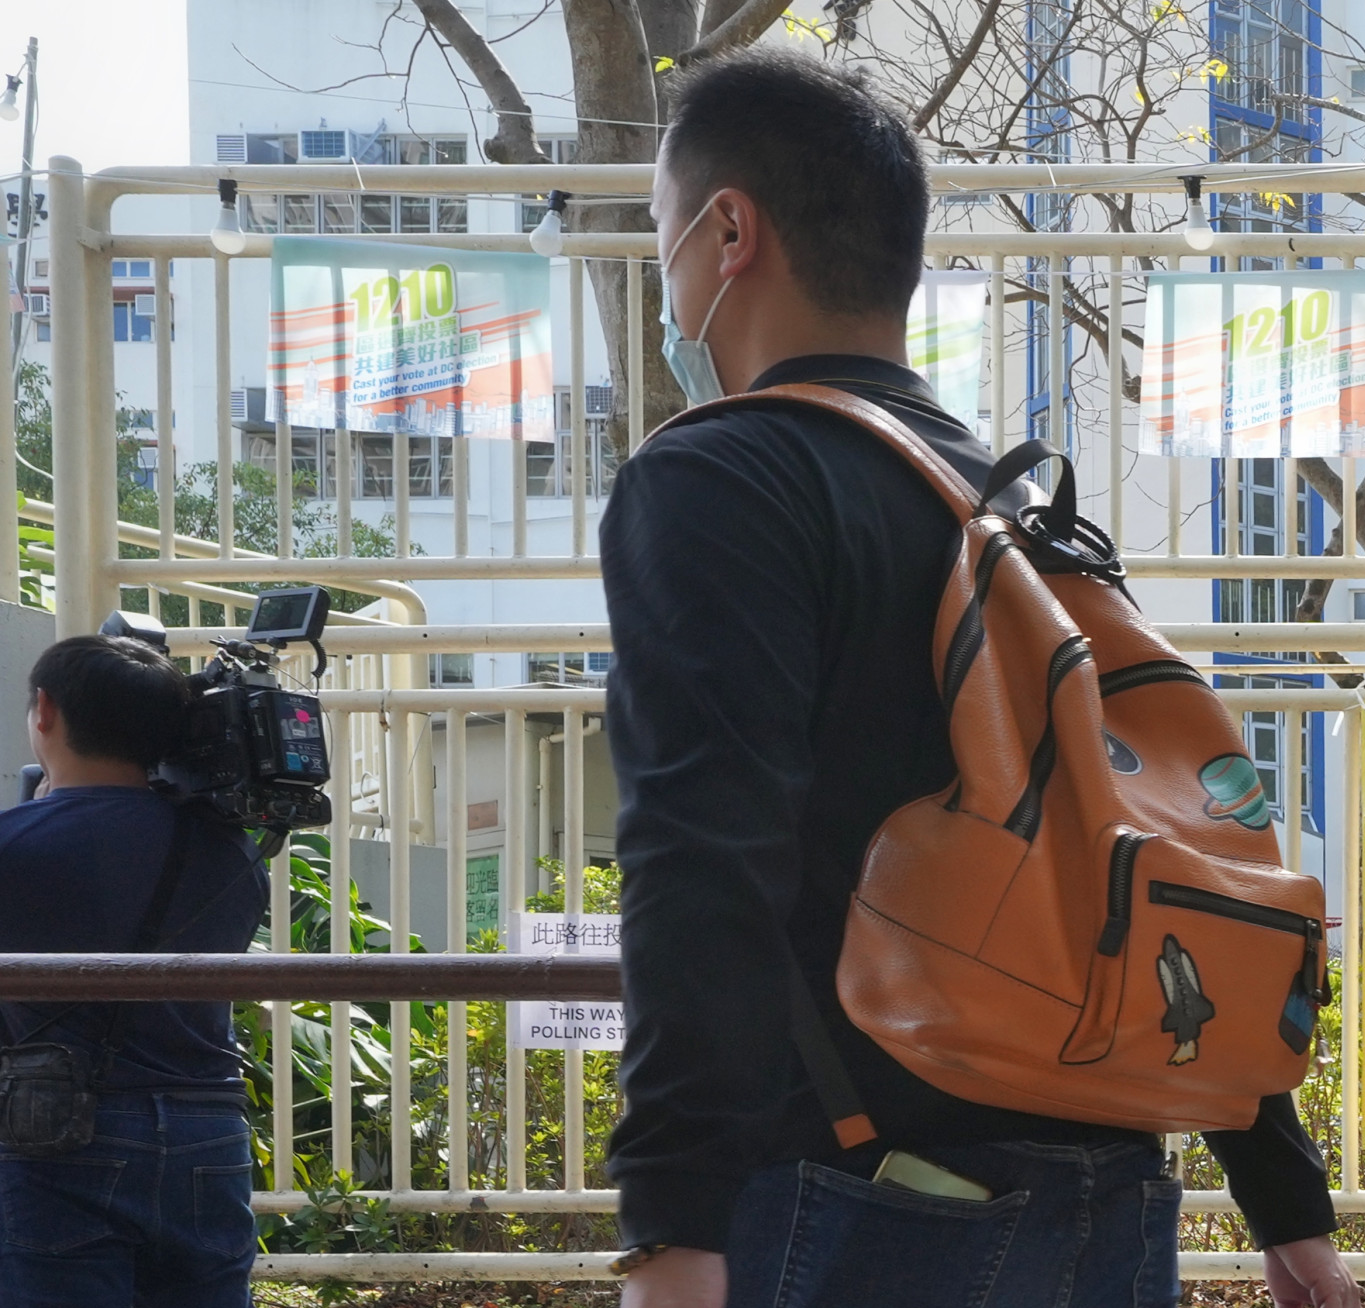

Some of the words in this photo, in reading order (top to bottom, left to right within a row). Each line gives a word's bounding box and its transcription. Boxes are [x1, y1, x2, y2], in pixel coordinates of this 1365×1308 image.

[350, 263, 454, 332] 1210
[1223, 291, 1329, 361] 1210
[353, 378, 376, 389] Cast
[379, 374, 399, 387] your
[402, 369, 424, 381] vote
[428, 366, 438, 376] at
[441, 362, 454, 373] DC
[456, 354, 497, 370] election
[354, 333, 478, 376] 共建美好社區
[353, 392, 367, 402] for
[379, 383, 408, 397] better
[412, 373, 468, 392] community
[549, 1008, 585, 1020] THIS
[590, 1008, 625, 1021] WAY
[531, 1026, 601, 1039] POLLING
